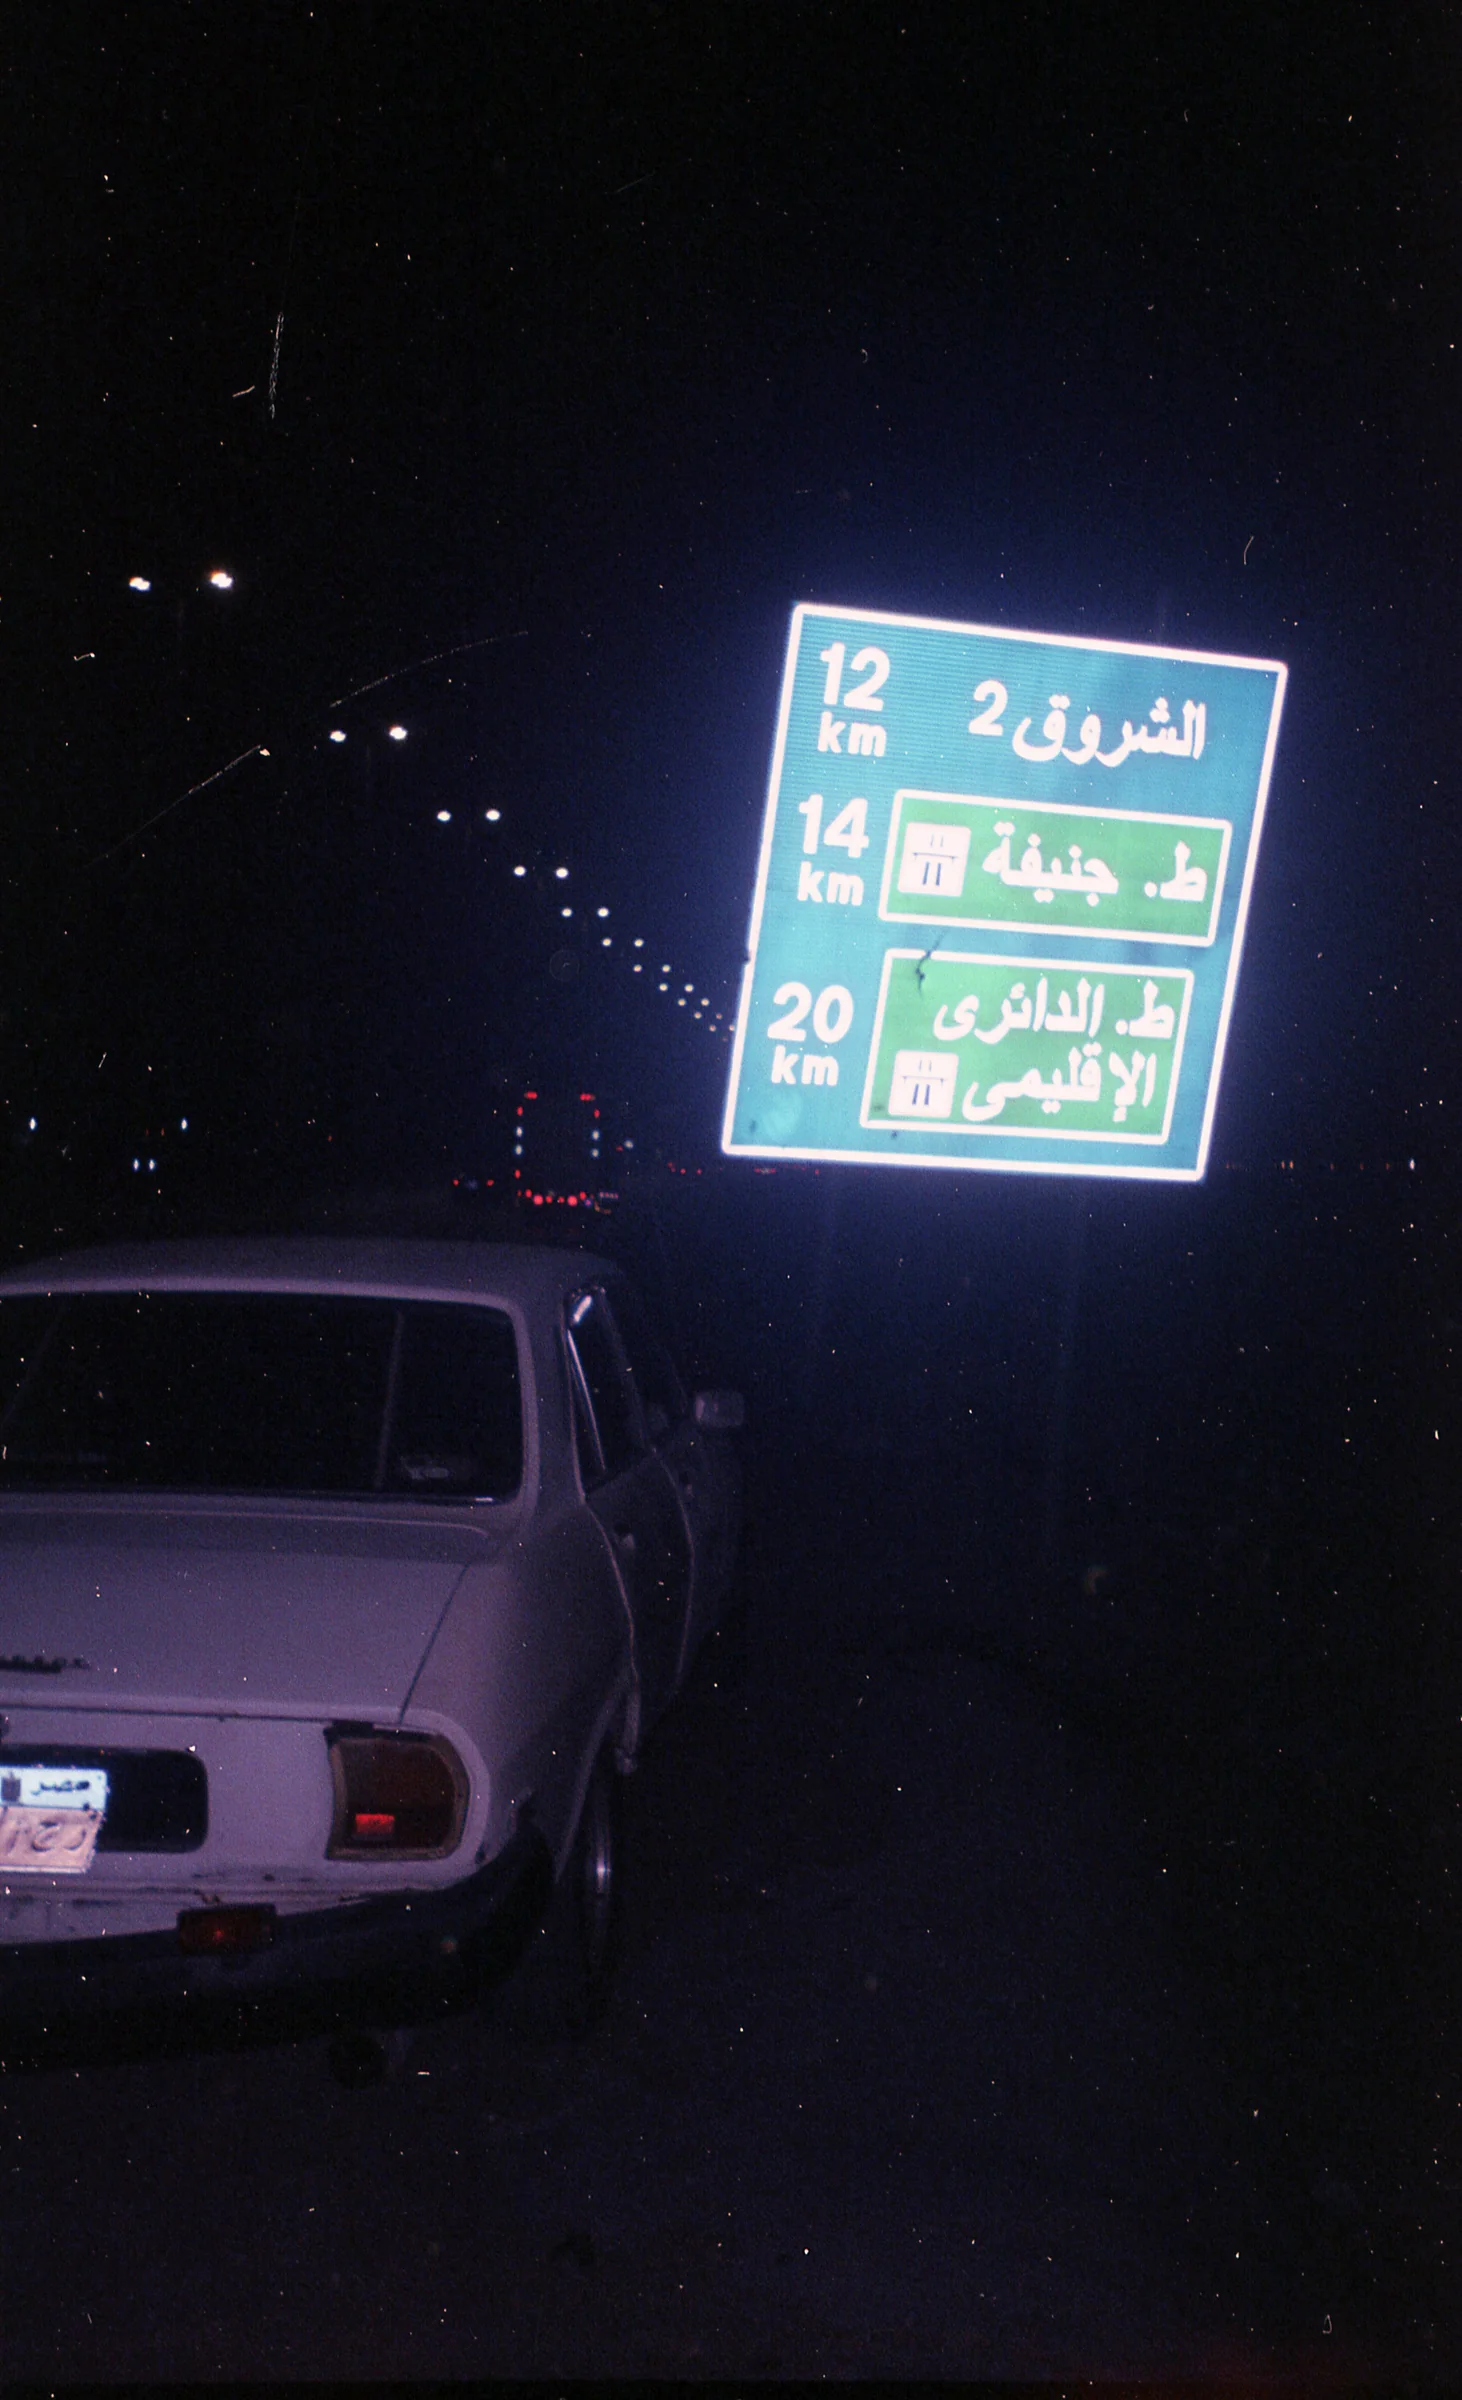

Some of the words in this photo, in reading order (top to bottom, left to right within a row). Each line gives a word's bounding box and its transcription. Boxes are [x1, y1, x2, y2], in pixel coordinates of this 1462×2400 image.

[819, 641, 891, 712] 12
[967, 679, 1009, 737] 2
[816, 710, 887, 757] km
[1011, 693, 1207, 767] الشروق
[797, 792, 870, 859] 14
[796, 860, 866, 906] km
[980, 820, 1120, 907] جنيفة
[766, 980, 855, 1045] 20
[770, 1044, 840, 1088] km
